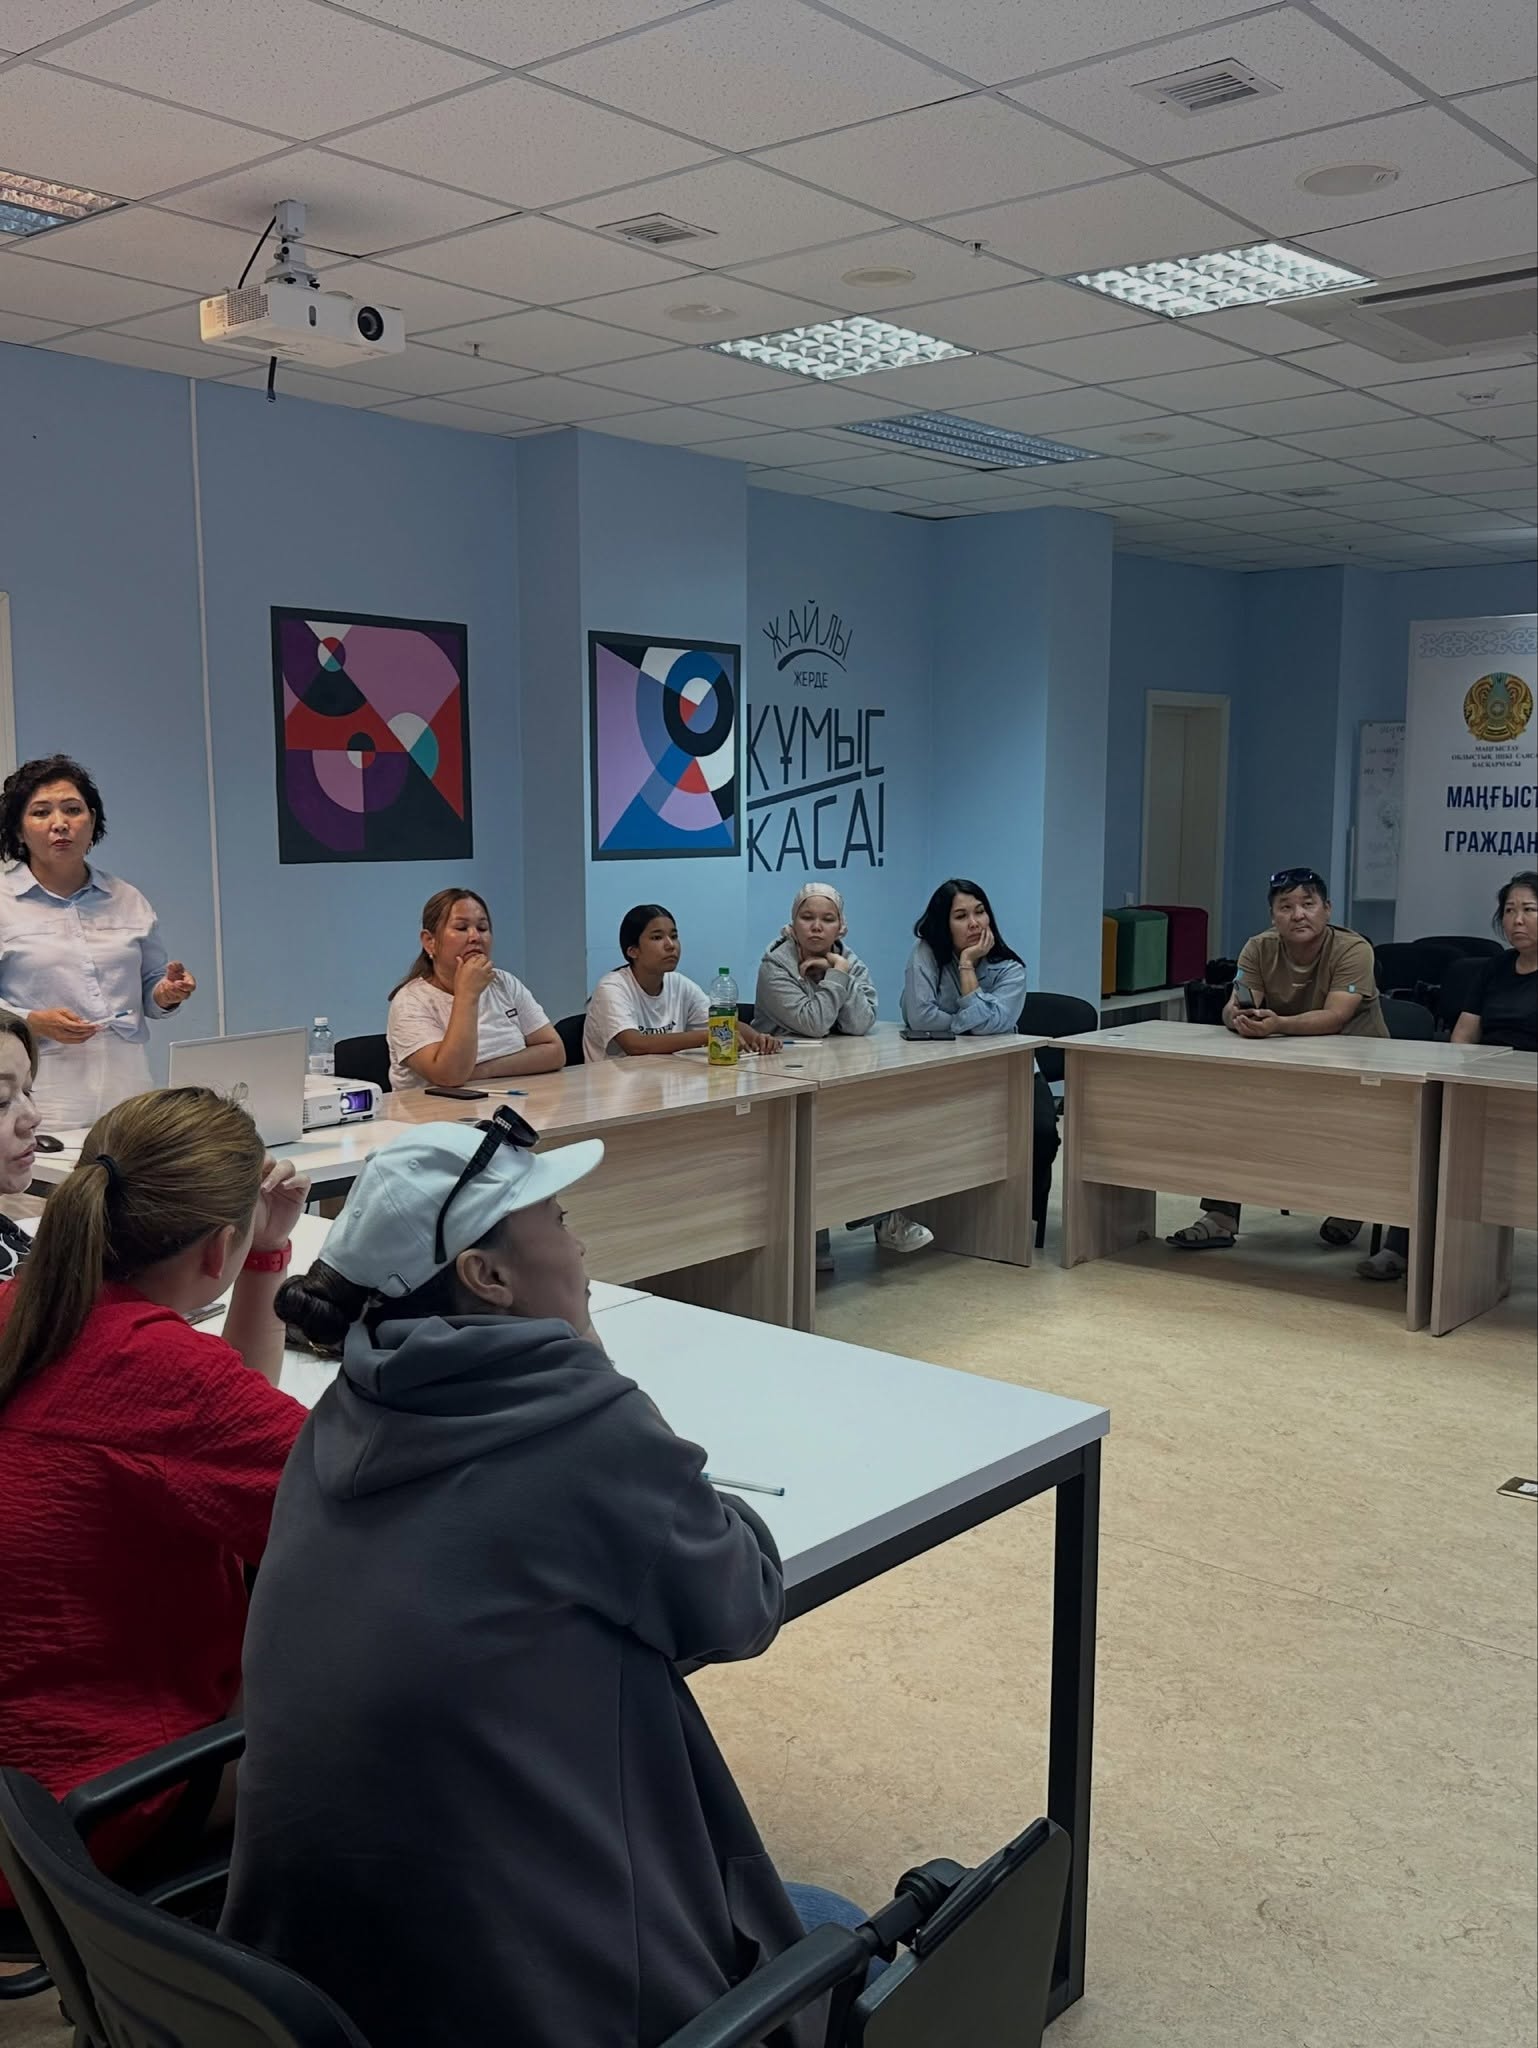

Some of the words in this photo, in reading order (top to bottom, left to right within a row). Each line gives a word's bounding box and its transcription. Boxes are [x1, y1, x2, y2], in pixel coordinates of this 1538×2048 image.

[761, 600, 854, 661] ЖАЙЛЫ
[793, 671, 829, 689] ЖЕРДЕ
[1444, 831, 1538, 856] ГРАЖДАН
